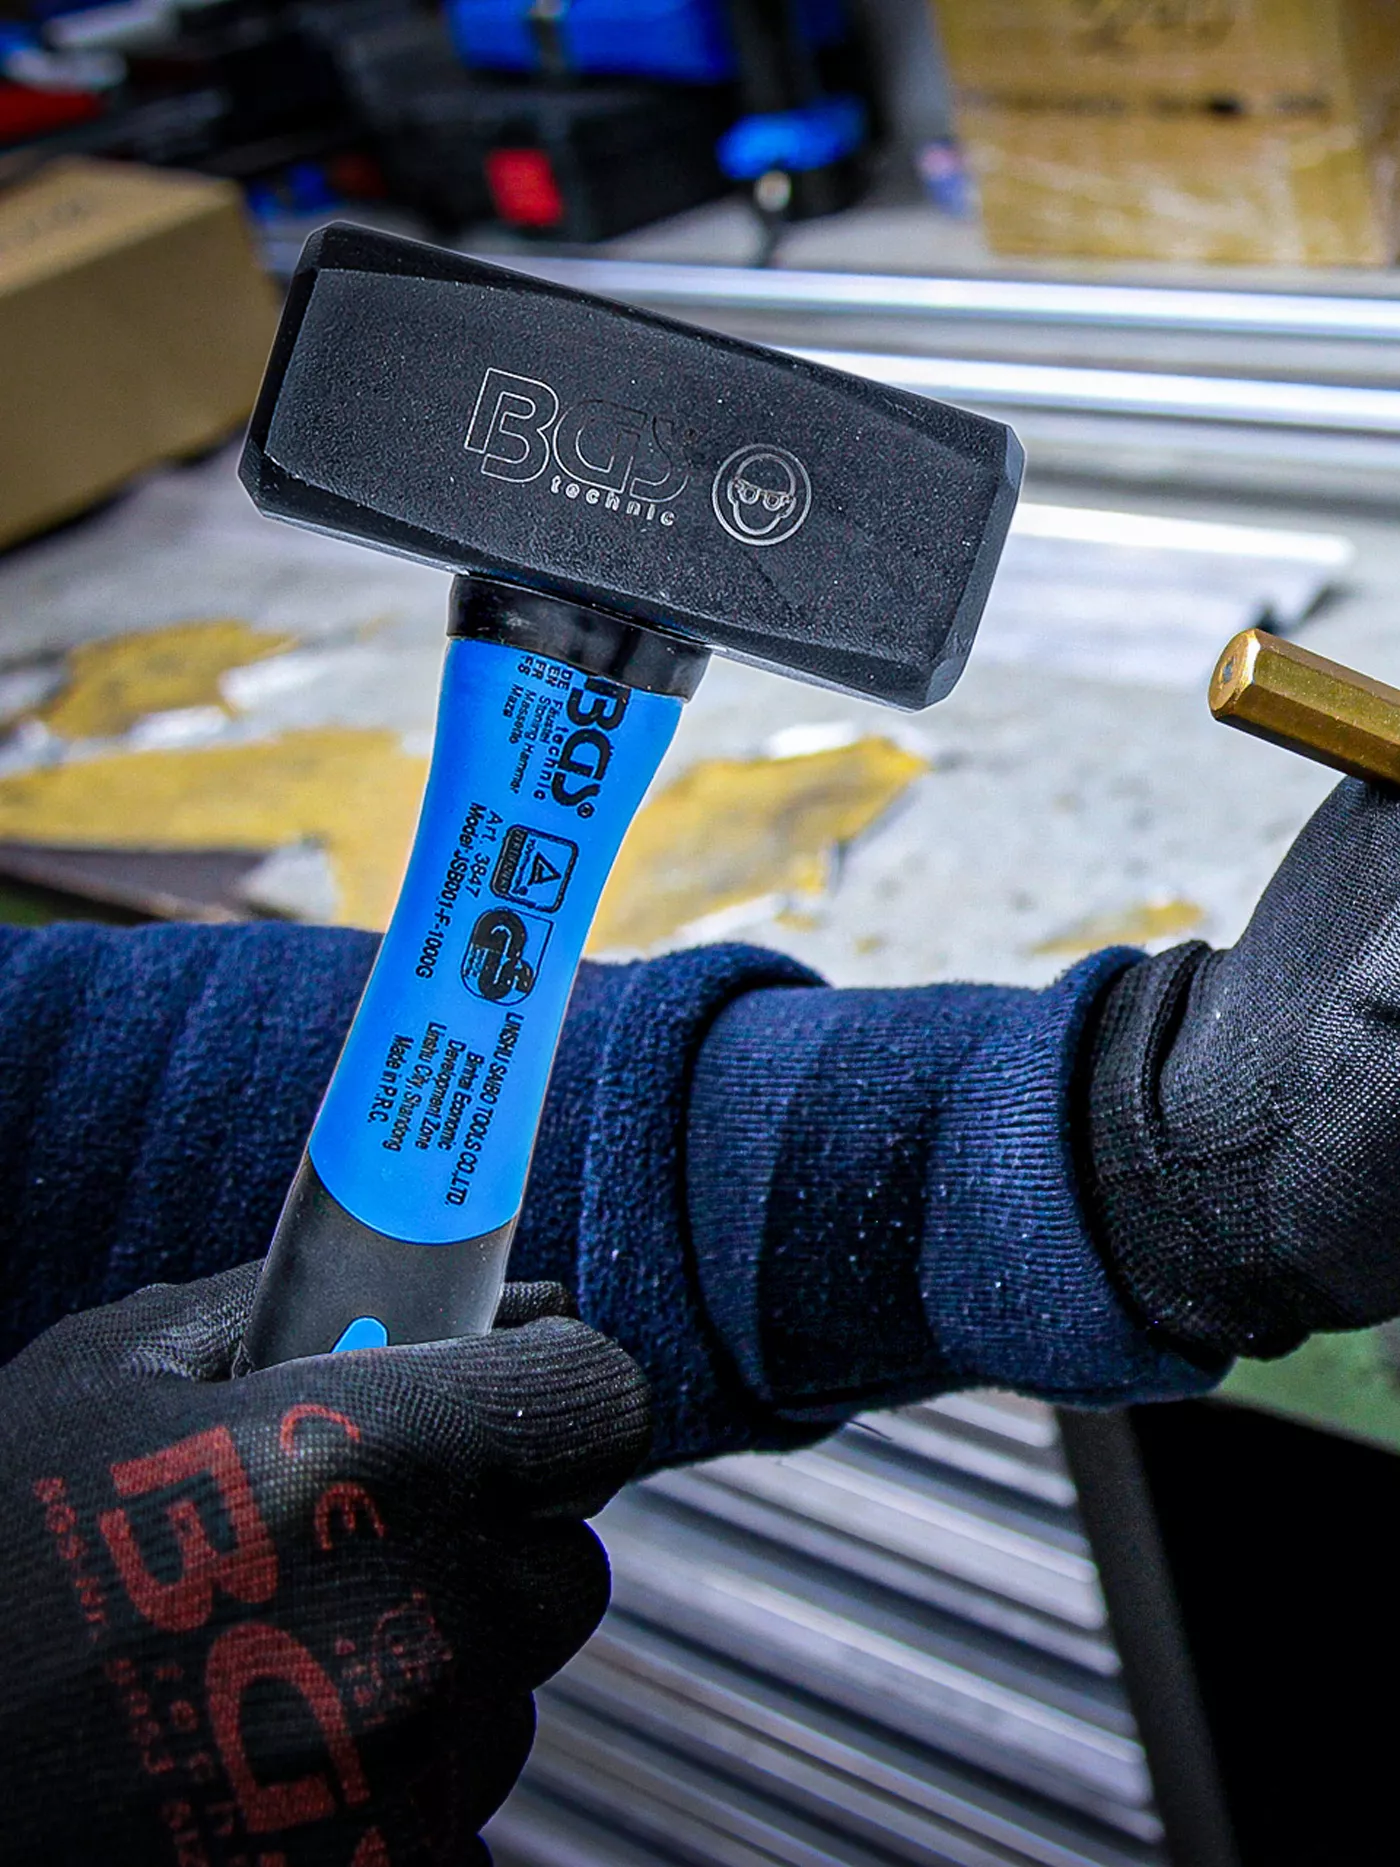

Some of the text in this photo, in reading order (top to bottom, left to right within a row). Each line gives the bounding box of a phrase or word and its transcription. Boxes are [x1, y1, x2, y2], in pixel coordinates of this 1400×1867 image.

[551, 474, 675, 526] technic
[509, 742, 534, 795] Hammer
[532, 724, 568, 800] technic
[464, 810, 503, 898] Art. 3847
[385, 1033, 413, 1071] Made
[418, 1021, 446, 1063] Linshu
[492, 1011, 524, 1063] LINSHU
[381, 1069, 401, 1084] in
[414, 1038, 466, 1151] Development Zone
[478, 1062, 507, 1105] SAIBO
[382, 1091, 422, 1151] Shandong
[437, 1091, 471, 1151] Economic
[463, 1105, 493, 1151] TOOLS
